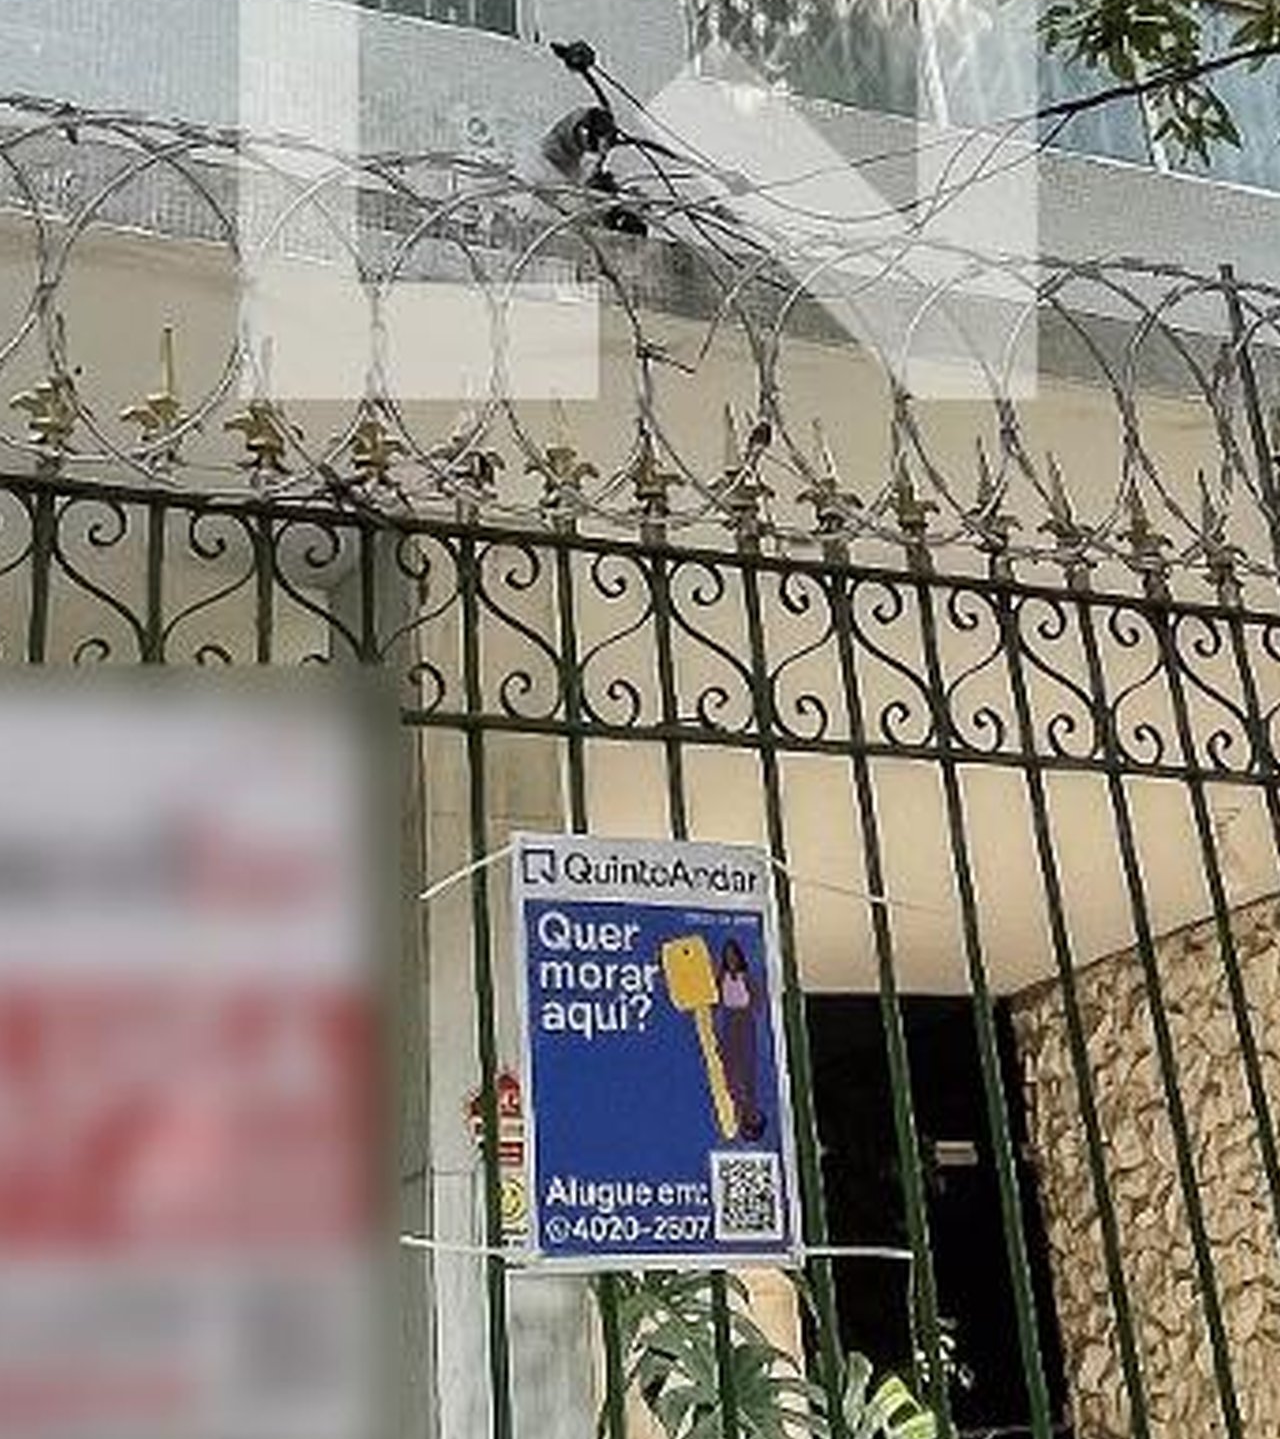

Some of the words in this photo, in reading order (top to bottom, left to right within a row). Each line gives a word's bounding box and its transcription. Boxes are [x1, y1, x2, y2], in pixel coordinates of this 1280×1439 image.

[564, 852, 757, 892] QuintoAndar
[538, 911, 640, 952] Quer
[540, 960, 660, 993] morar
[542, 995, 652, 1041] aqui?
[546, 1175, 652, 1213] Alugue
[658, 1179, 710, 1206] em:
